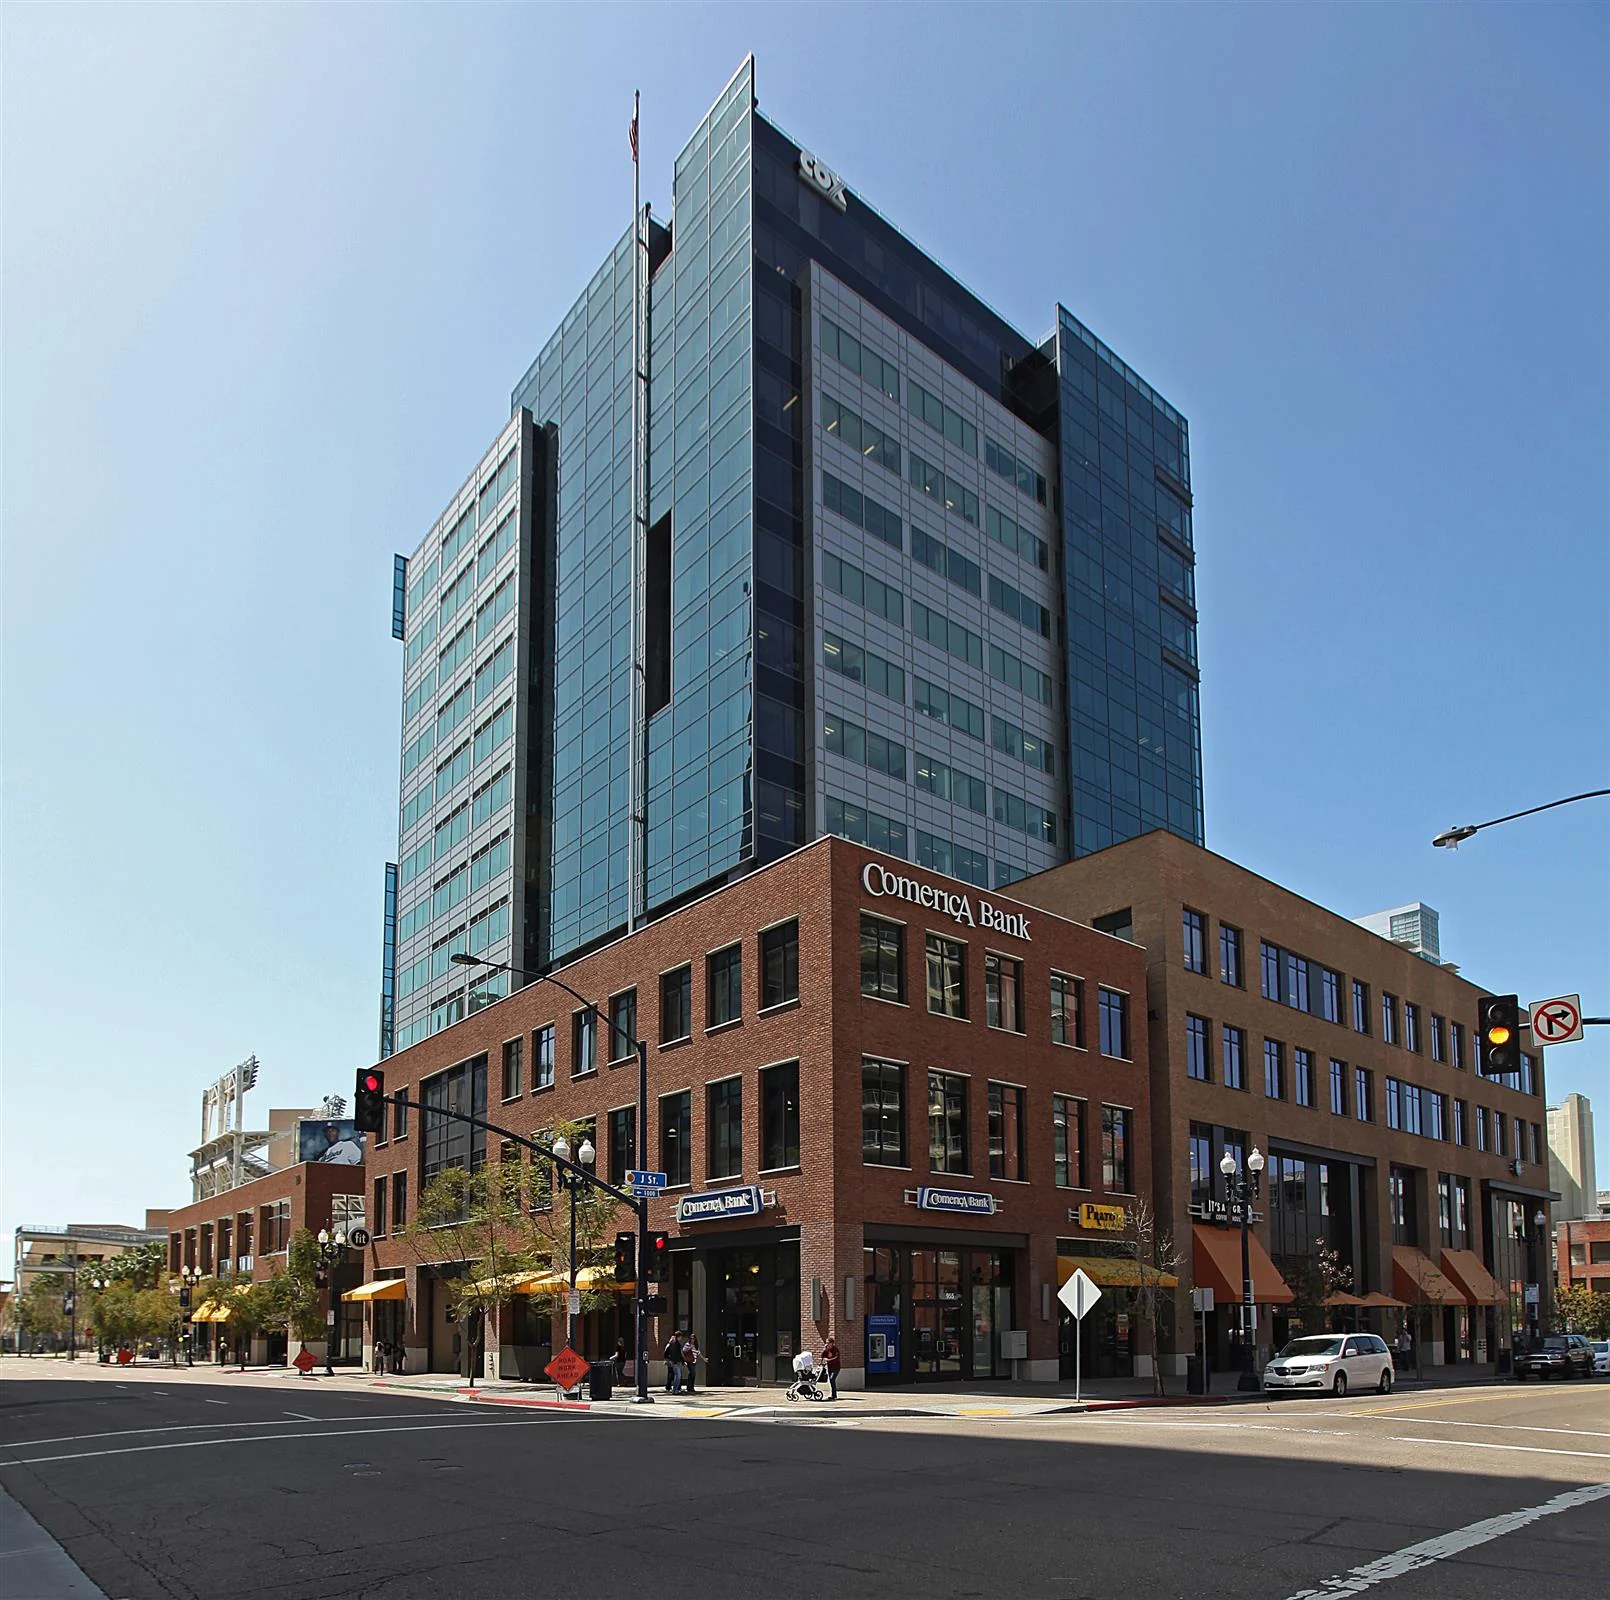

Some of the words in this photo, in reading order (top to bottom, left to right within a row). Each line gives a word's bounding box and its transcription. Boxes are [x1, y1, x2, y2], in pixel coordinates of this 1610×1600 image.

[978, 899, 1033, 942] Bank
[640, 1174, 645, 1184] J
[724, 1192, 752, 1209] Bank
[968, 1196, 989, 1208] Bank
[1221, 1203, 1226, 1212] A
[355, 1231, 366, 1244] fit
